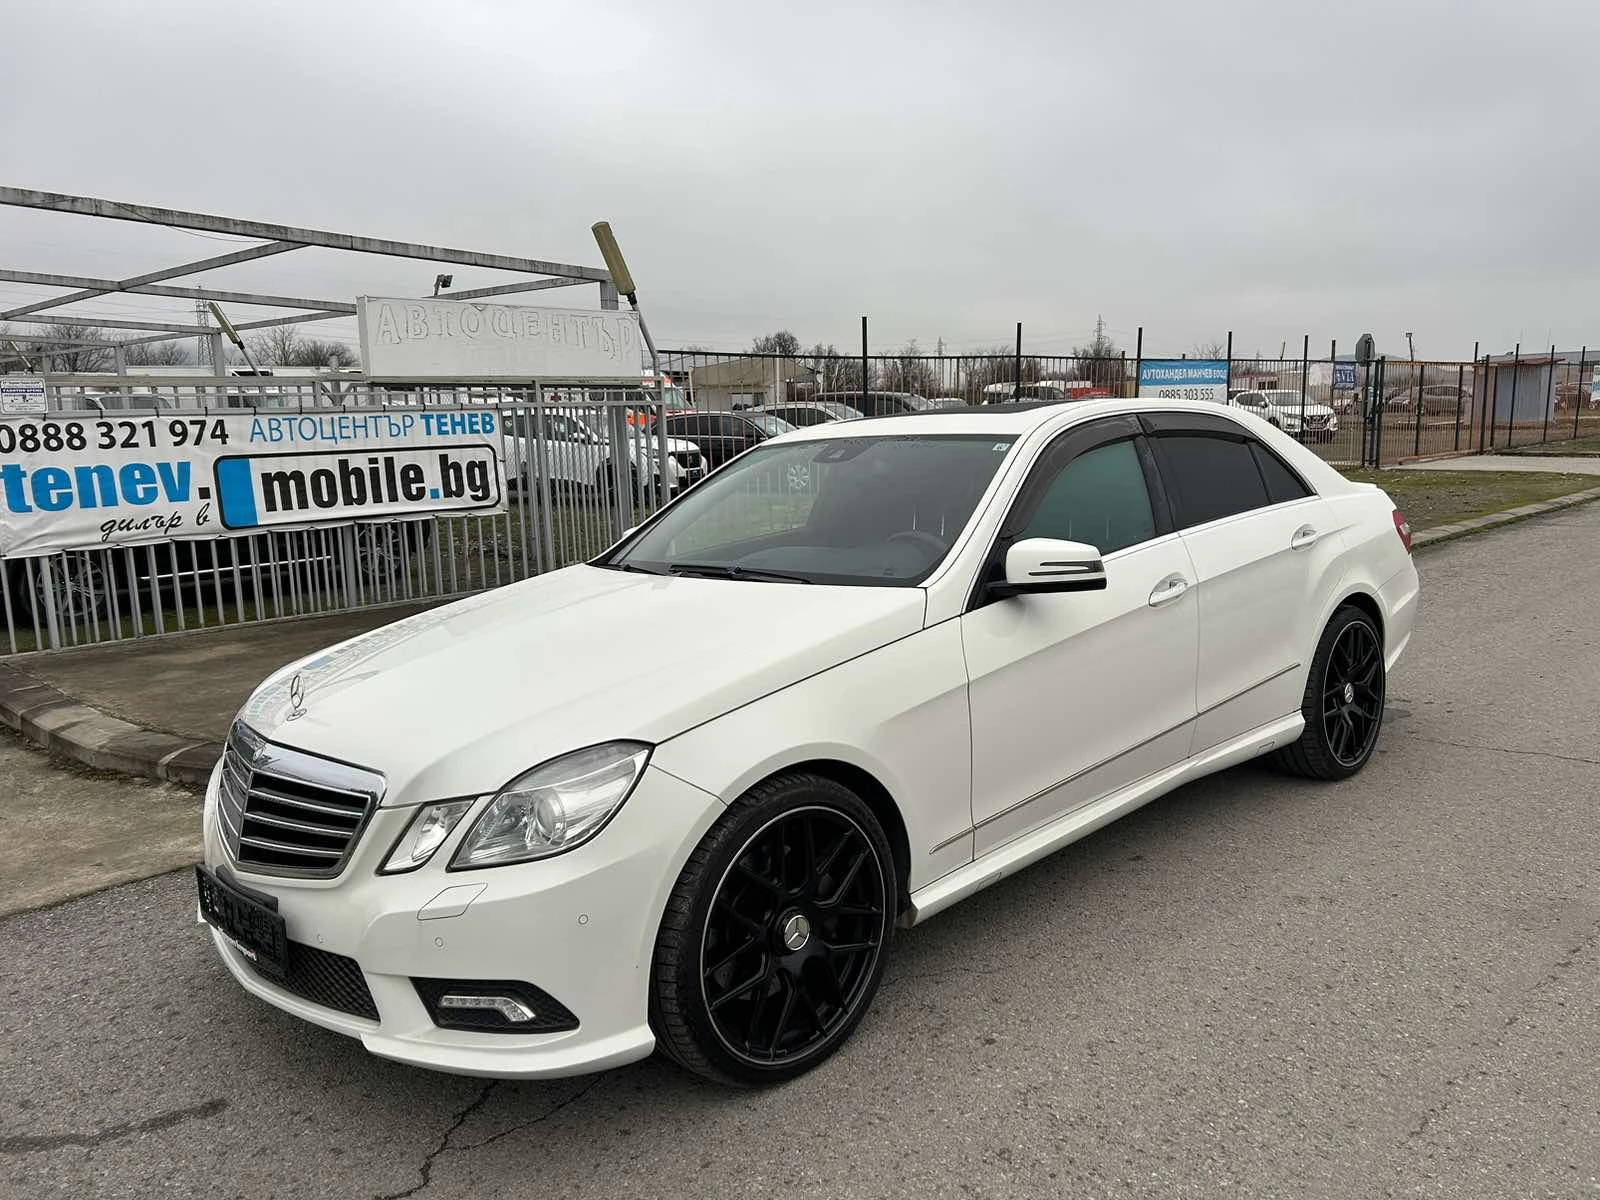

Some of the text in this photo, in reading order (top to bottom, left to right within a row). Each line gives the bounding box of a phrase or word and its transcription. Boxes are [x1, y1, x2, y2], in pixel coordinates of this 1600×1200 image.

[376, 303, 639, 360] АВТОЦЕНТЪР
[1184, 388, 1198, 401] 303
[1200, 388, 1214, 401] 555
[0, 419, 229, 454] 0888 321 974
[250, 412, 495, 444] АВТОЦЕНТЪР ТЕНЕВ
[261, 454, 491, 513] mobile.bg
